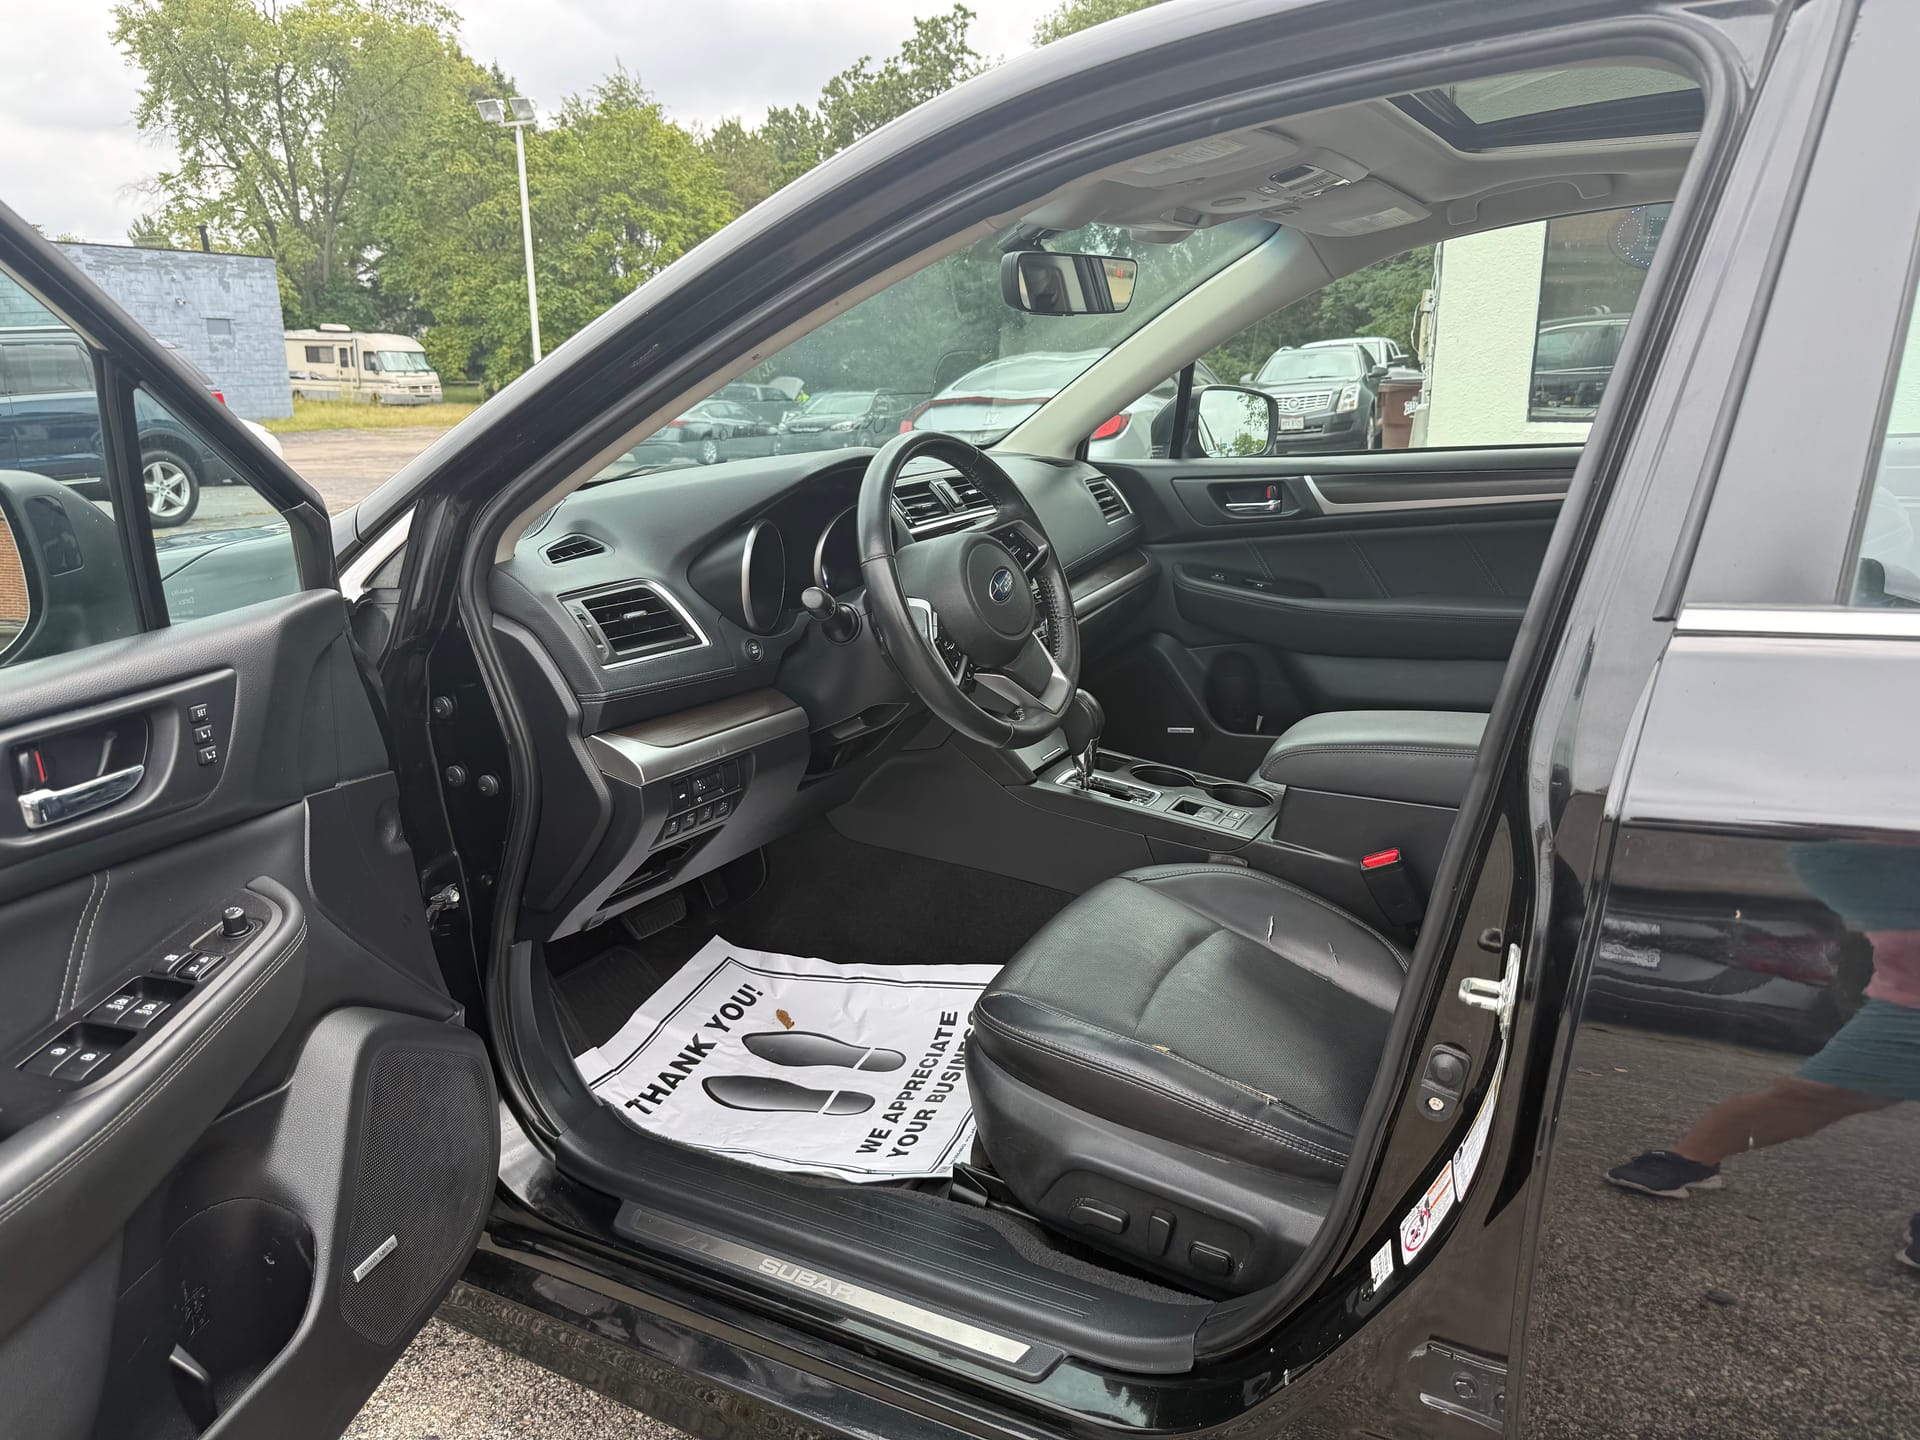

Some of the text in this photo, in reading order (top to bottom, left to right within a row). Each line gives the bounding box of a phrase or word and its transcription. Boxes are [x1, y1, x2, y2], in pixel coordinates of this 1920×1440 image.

[624, 983, 764, 1115] THANK YOU!
[855, 1010, 958, 1155] WE APPRECIATE
[885, 1109, 937, 1157] YOUR
